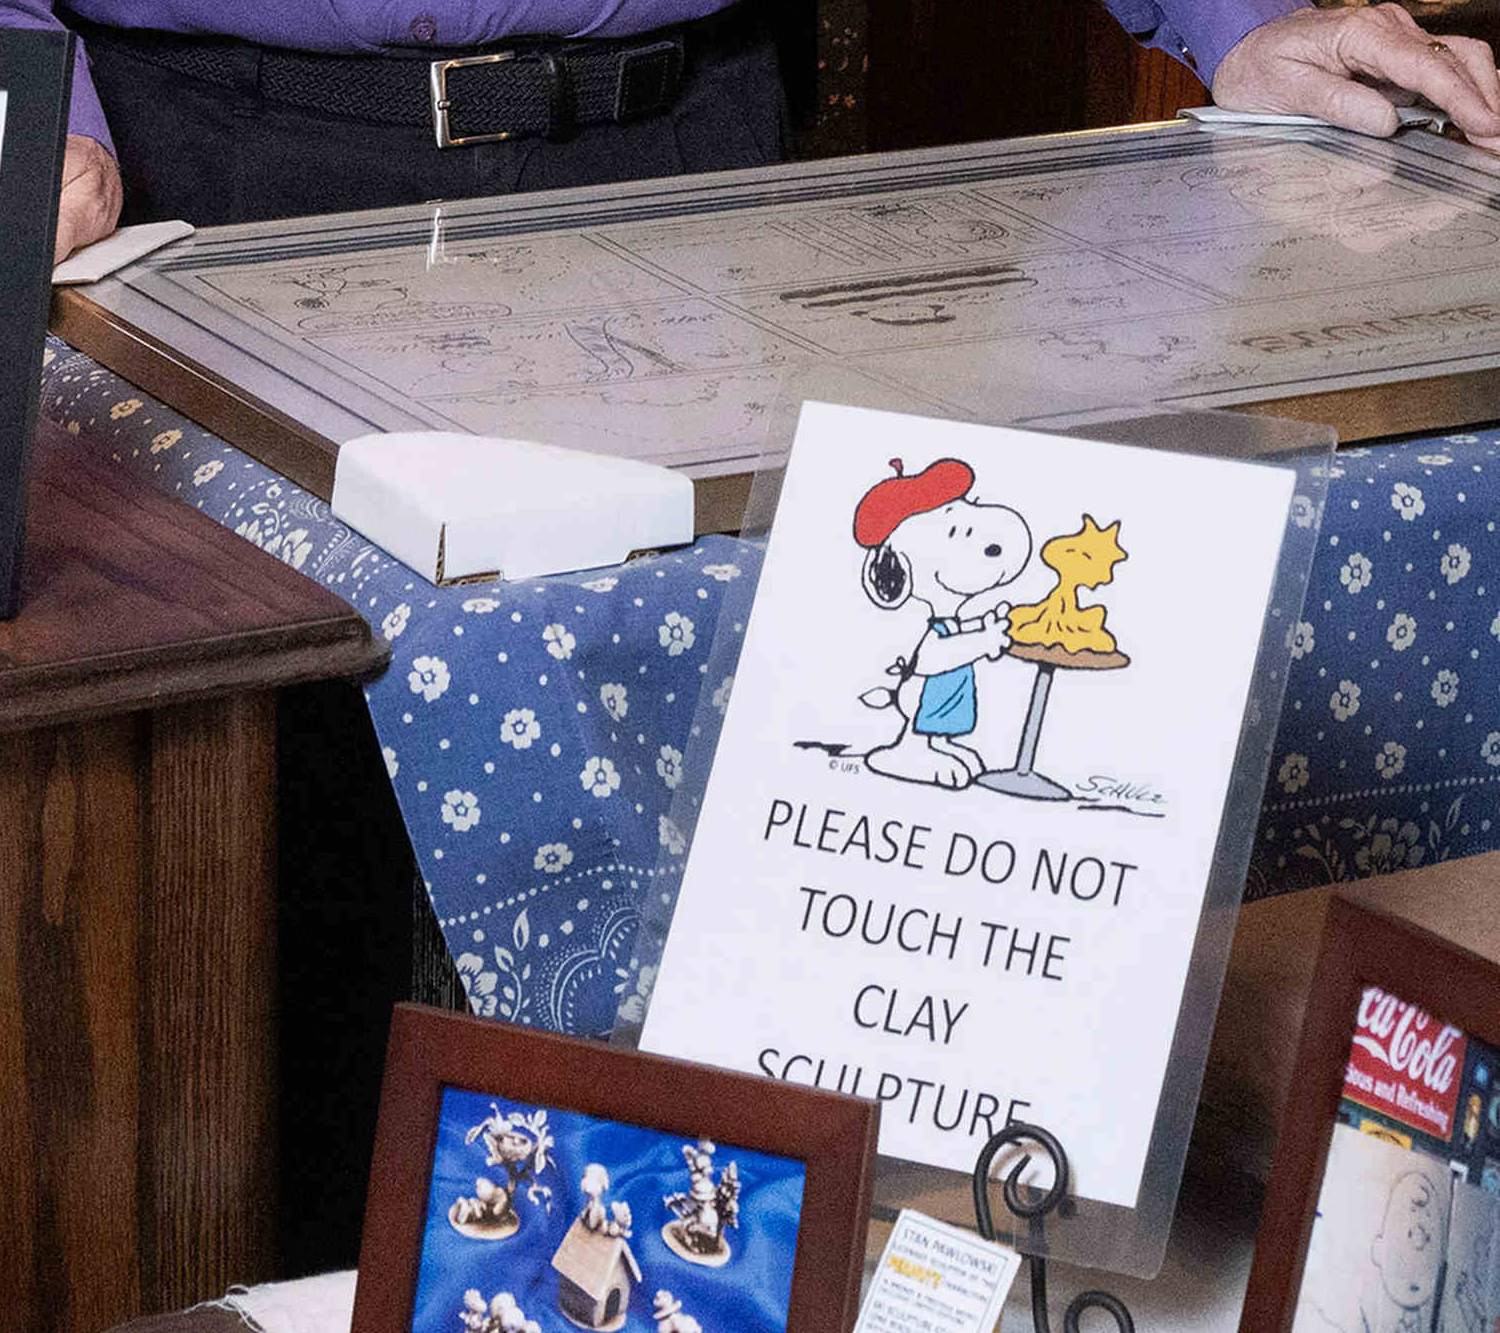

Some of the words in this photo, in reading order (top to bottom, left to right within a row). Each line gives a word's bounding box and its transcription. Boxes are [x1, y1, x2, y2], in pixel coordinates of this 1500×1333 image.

[764, 799, 932, 869] PLEASE
[944, 833, 1016, 884] DO
[1031, 849, 1138, 906] NOT
[800, 887, 962, 960] TOUCH
[981, 921, 1071, 981] THE
[853, 985, 969, 1044] CLAY
[1375, 1079, 1397, 1101] and
